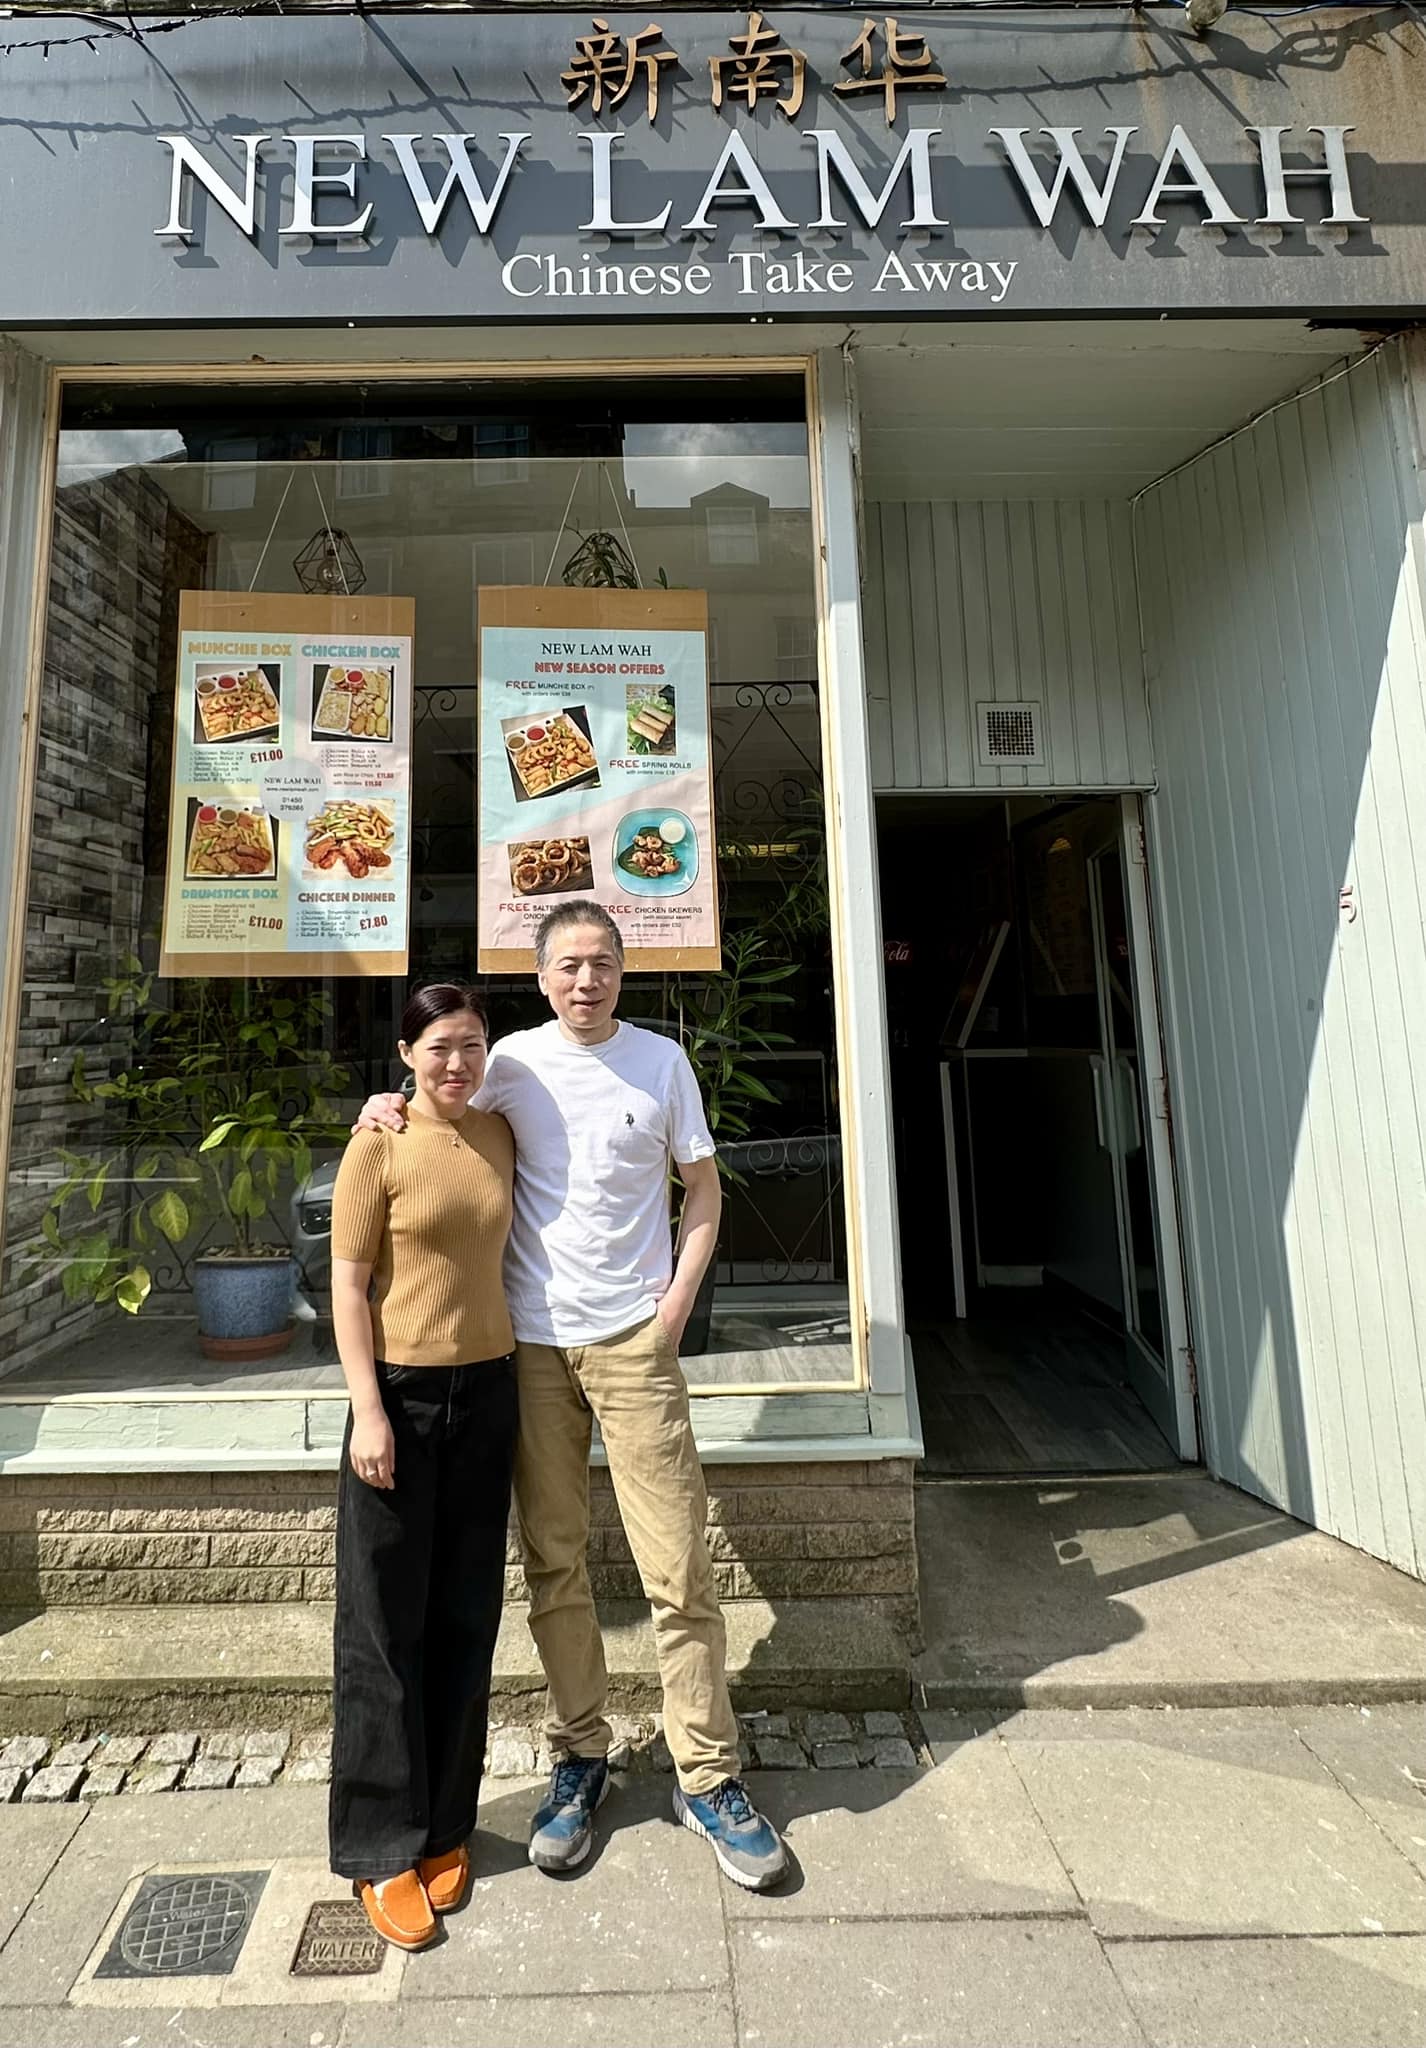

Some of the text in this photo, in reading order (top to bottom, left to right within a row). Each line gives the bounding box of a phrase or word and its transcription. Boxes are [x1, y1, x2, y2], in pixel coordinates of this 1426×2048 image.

[560, 12, 947, 126] 新南华
[154, 125, 1371, 235] NEW LAM WAH
[502, 250, 1018, 302] Chinese Take Away
[188, 642, 292, 656] MUNCHIE BOX
[301, 645, 400, 658] CHICKEN BOX
[542, 643, 651, 656] NEW LAM WAH
[535, 662, 665, 674] NEW SEASON OFFERS
[506, 681, 536, 689] FREE
[538, 682, 569, 690] MUNCHIE
[250, 749, 283, 763] £11.00
[609, 760, 639, 768] FREE
[182, 889, 278, 899] DRUMSTICK BOX
[298, 892, 396, 902] CHICKEN DINNER
[499, 903, 530, 912] FREE
[249, 915, 283, 930] £11.00
[360, 915, 388, 930] £7.80
[312, 1942, 375, 1958] WATER
